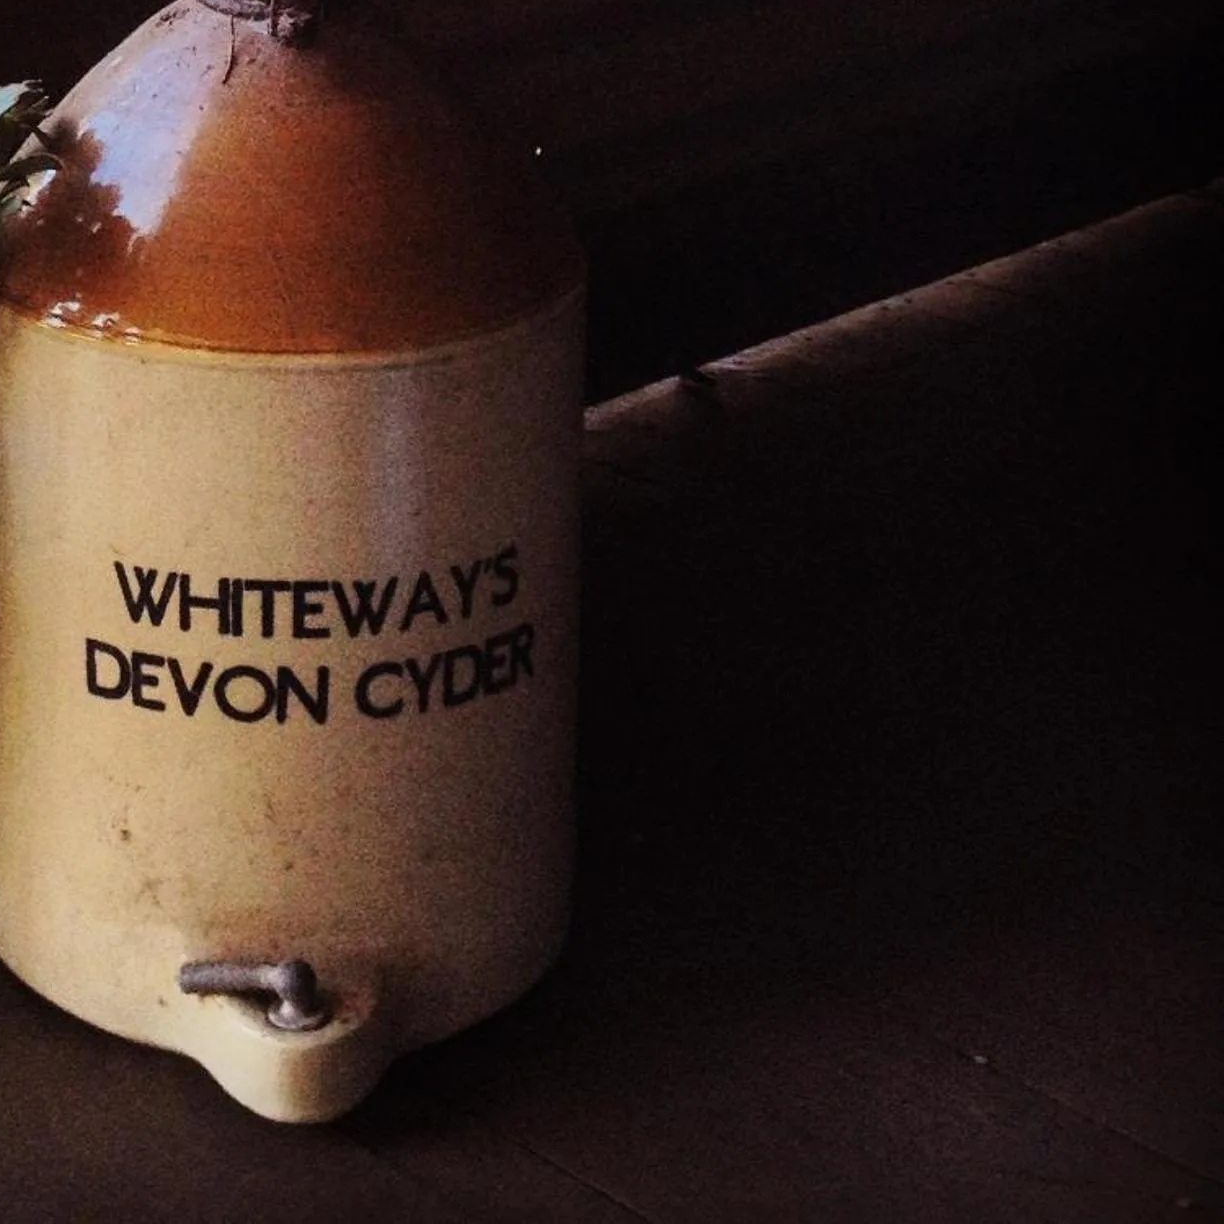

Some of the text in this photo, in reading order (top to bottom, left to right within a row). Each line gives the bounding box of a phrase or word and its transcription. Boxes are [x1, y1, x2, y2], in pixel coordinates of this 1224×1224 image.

[113, 546, 519, 638] WHITEWAY'S
[86, 622, 535, 725] DEVON CYDER
